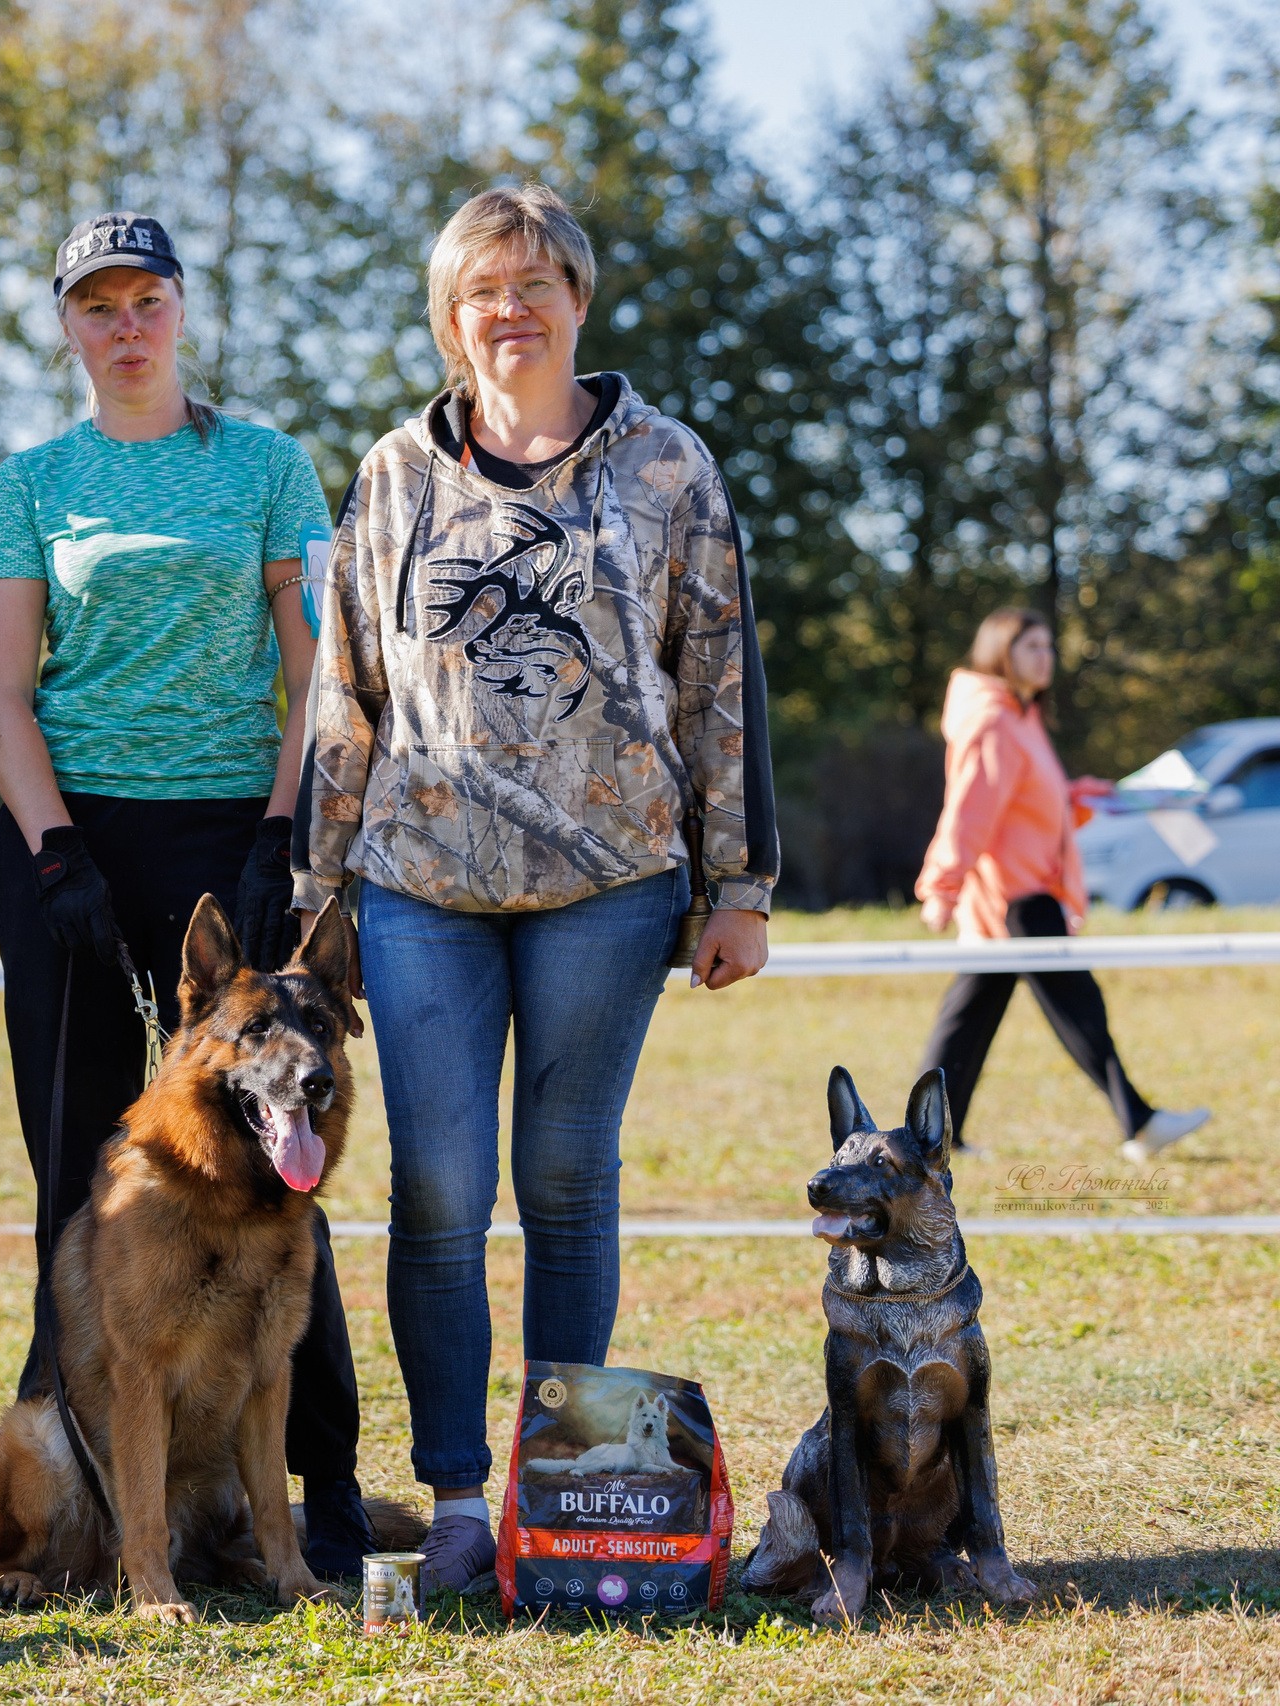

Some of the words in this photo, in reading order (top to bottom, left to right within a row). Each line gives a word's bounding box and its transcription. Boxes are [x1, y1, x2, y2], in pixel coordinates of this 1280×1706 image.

[65, 225, 154, 269] STYLE
[560, 1492, 670, 1515] BUFFALO
[576, 1515, 607, 1524] Premium
[521, 1532, 531, 1554] M/L
[552, 1539, 596, 1553] ADULT
[607, 1541, 678, 1557] SENSITIVE
